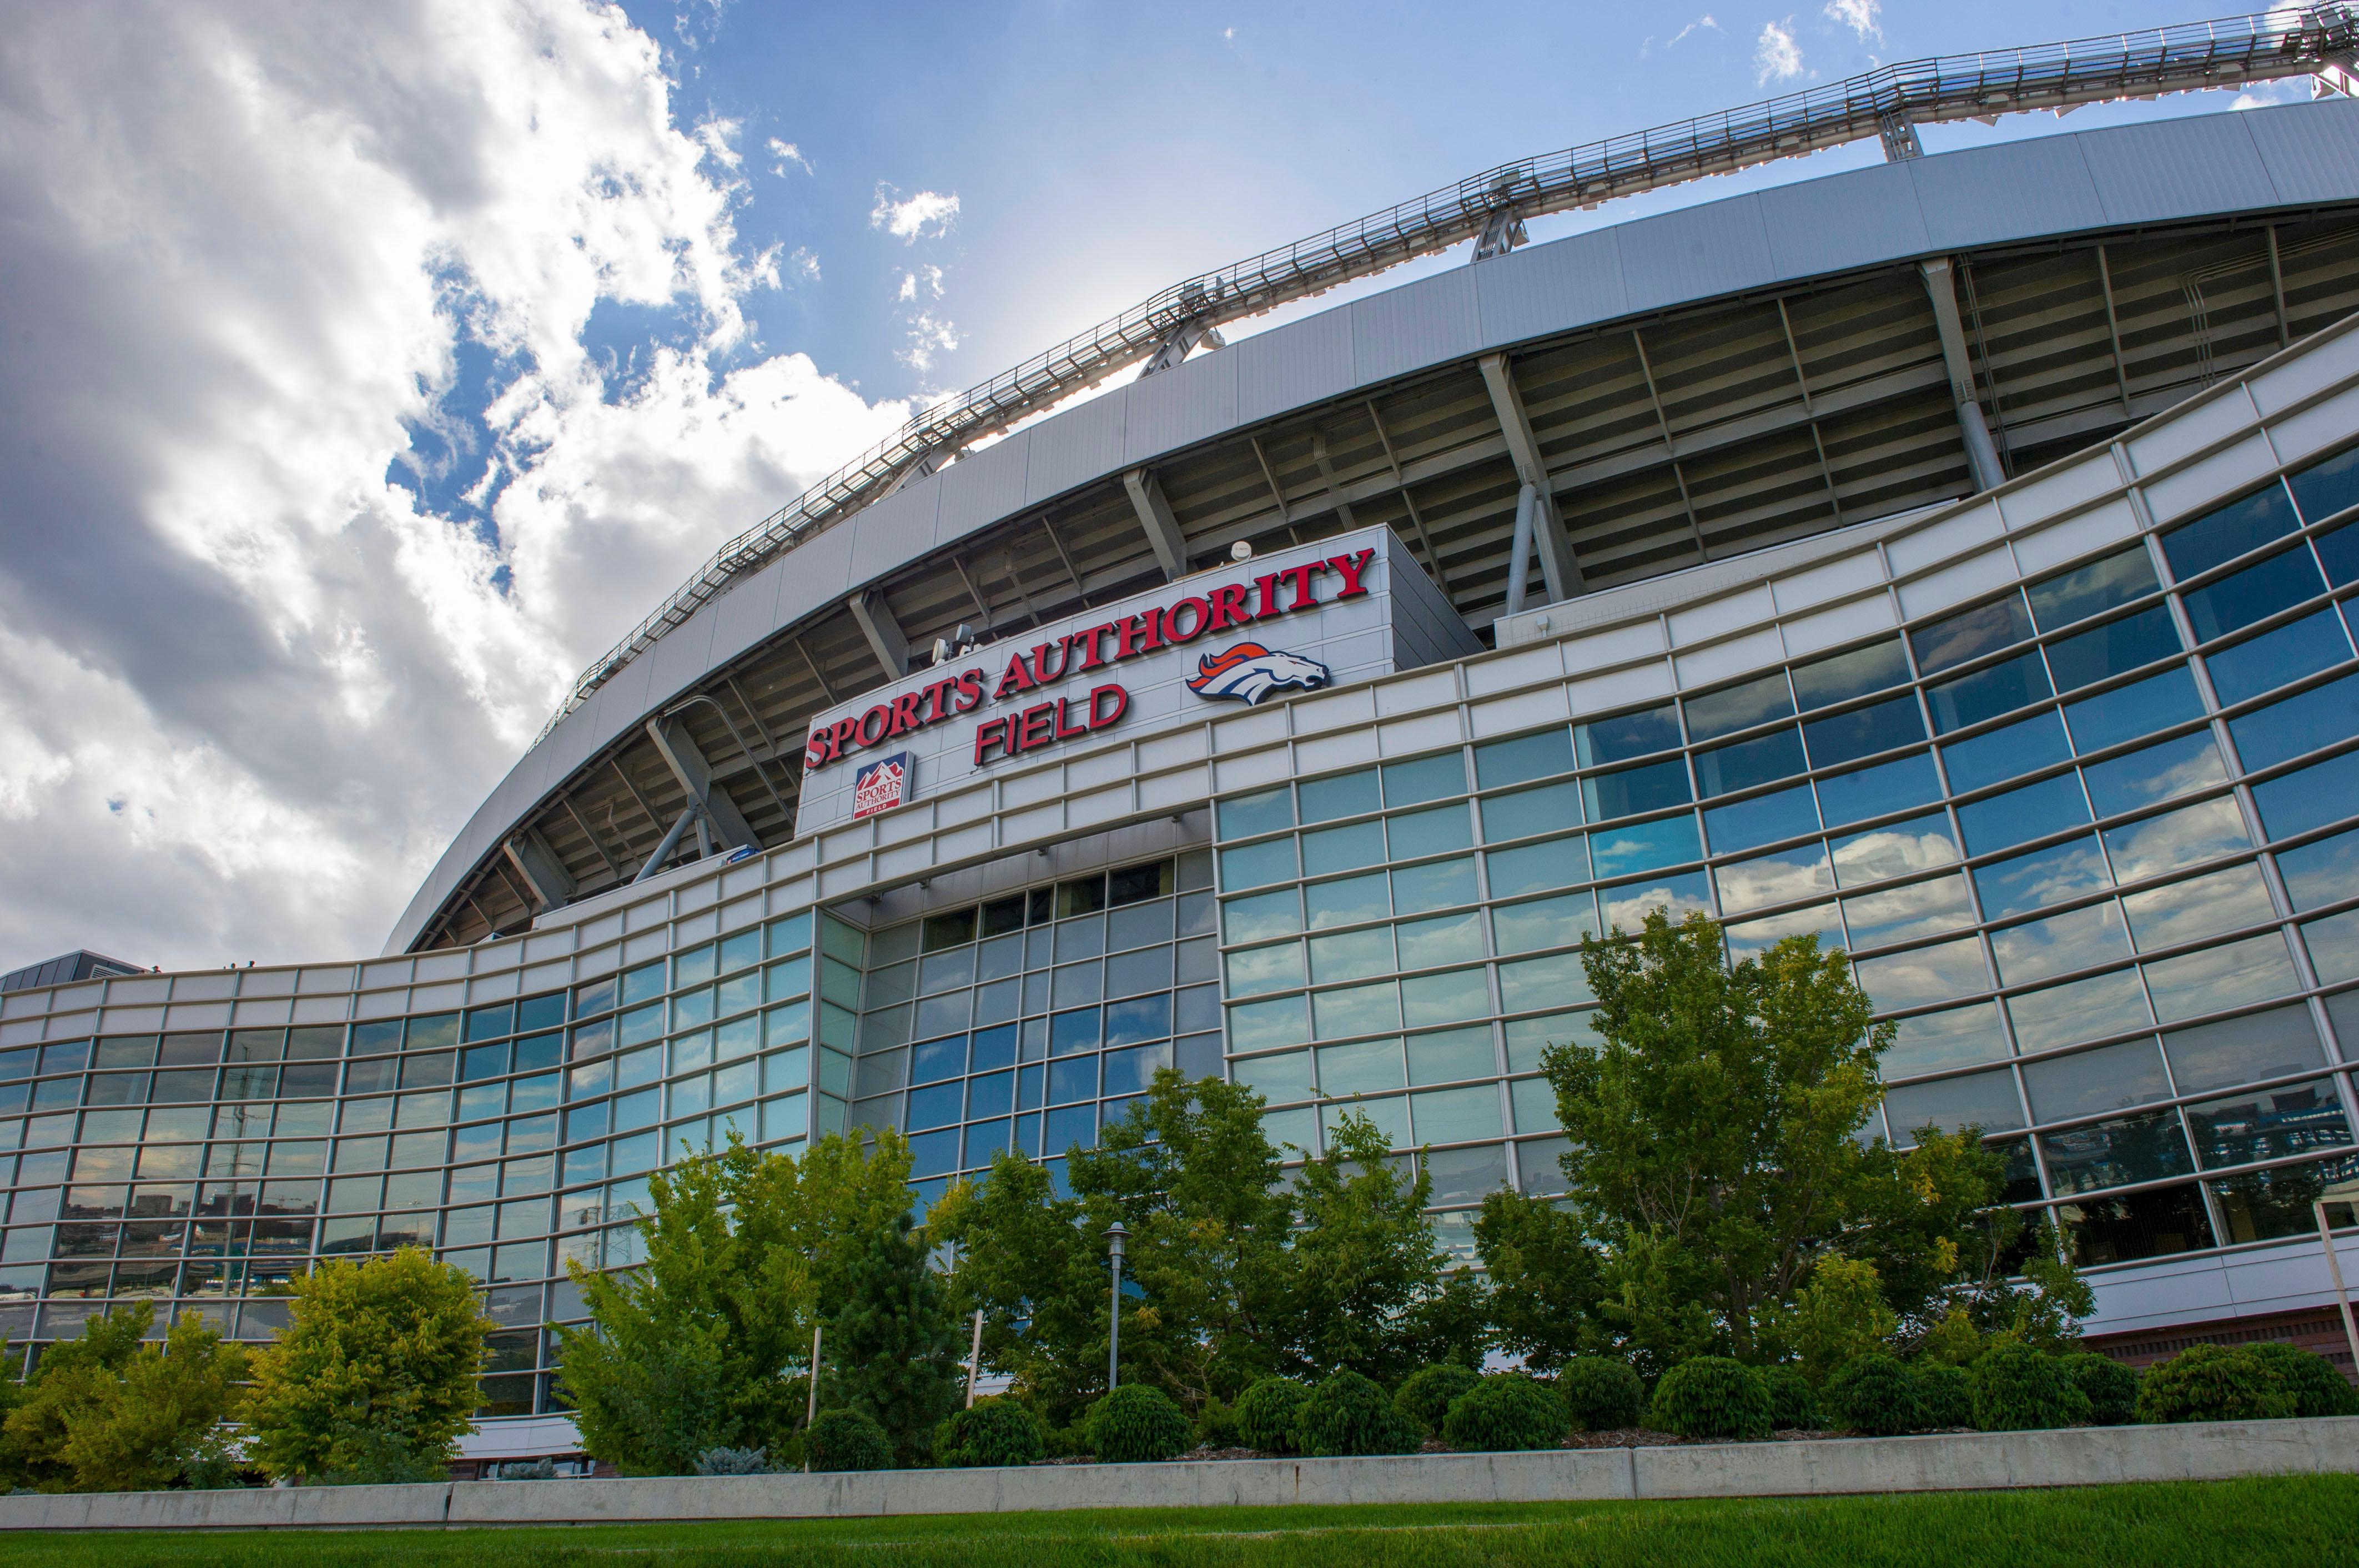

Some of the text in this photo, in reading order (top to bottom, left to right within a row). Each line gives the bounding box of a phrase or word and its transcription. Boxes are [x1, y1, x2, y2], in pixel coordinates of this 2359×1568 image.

[806, 548, 1374, 769] SPORTS AUTHORITY
[974, 684, 1128, 770] FIELD
[856, 789, 901, 811] AUTHORITY
[857, 778, 902, 803] SPORTS
[866, 803, 887, 815] FIELD
